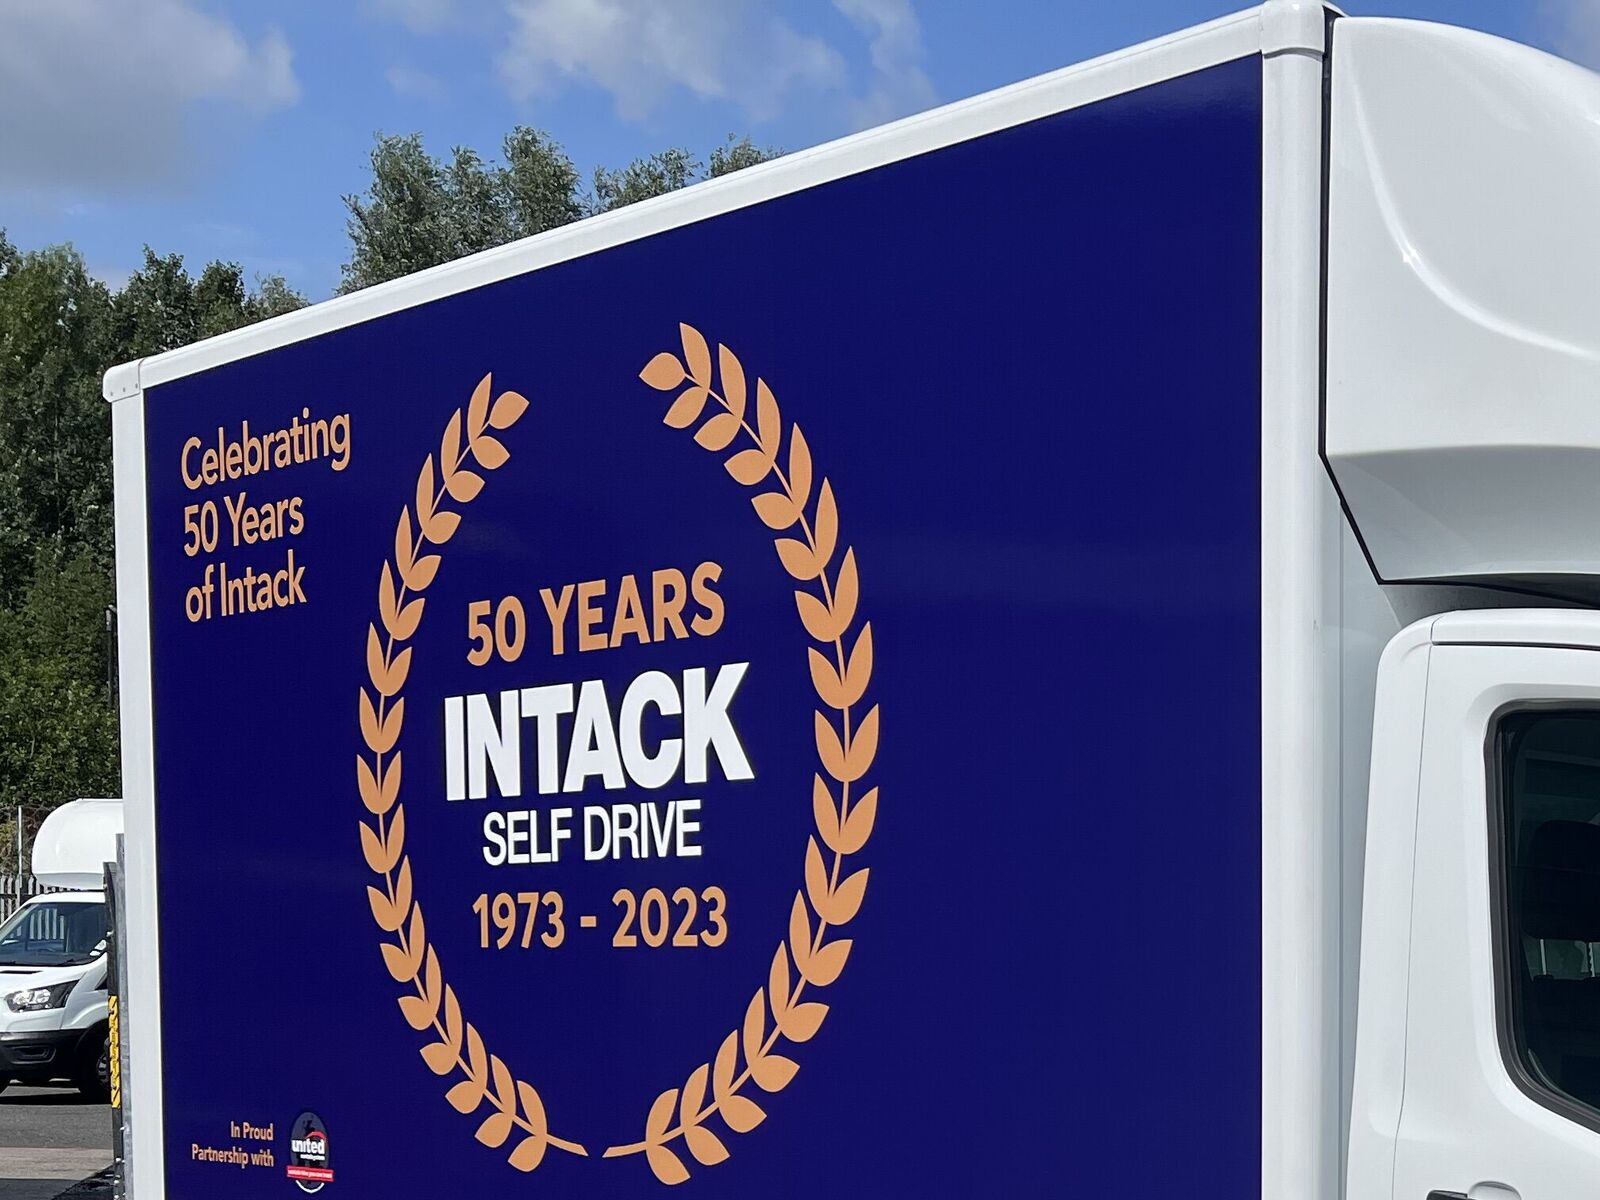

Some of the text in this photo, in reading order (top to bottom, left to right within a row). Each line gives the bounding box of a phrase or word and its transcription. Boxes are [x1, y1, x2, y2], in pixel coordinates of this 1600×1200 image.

[181, 407, 350, 490] Celebrating
[184, 491, 305, 557] 50 Years
[185, 548, 307, 623] of Intack
[466, 561, 725, 667] 50 YEARS
[444, 661, 755, 801] INTACK
[482, 799, 702, 867] SELF DRIVE
[472, 890, 565, 950] 1973
[612, 886, 728, 948] 2023
[192, 1144, 274, 1169] Partnership with
[231, 1121, 274, 1141] In Proud
[291, 1139, 325, 1155] united
